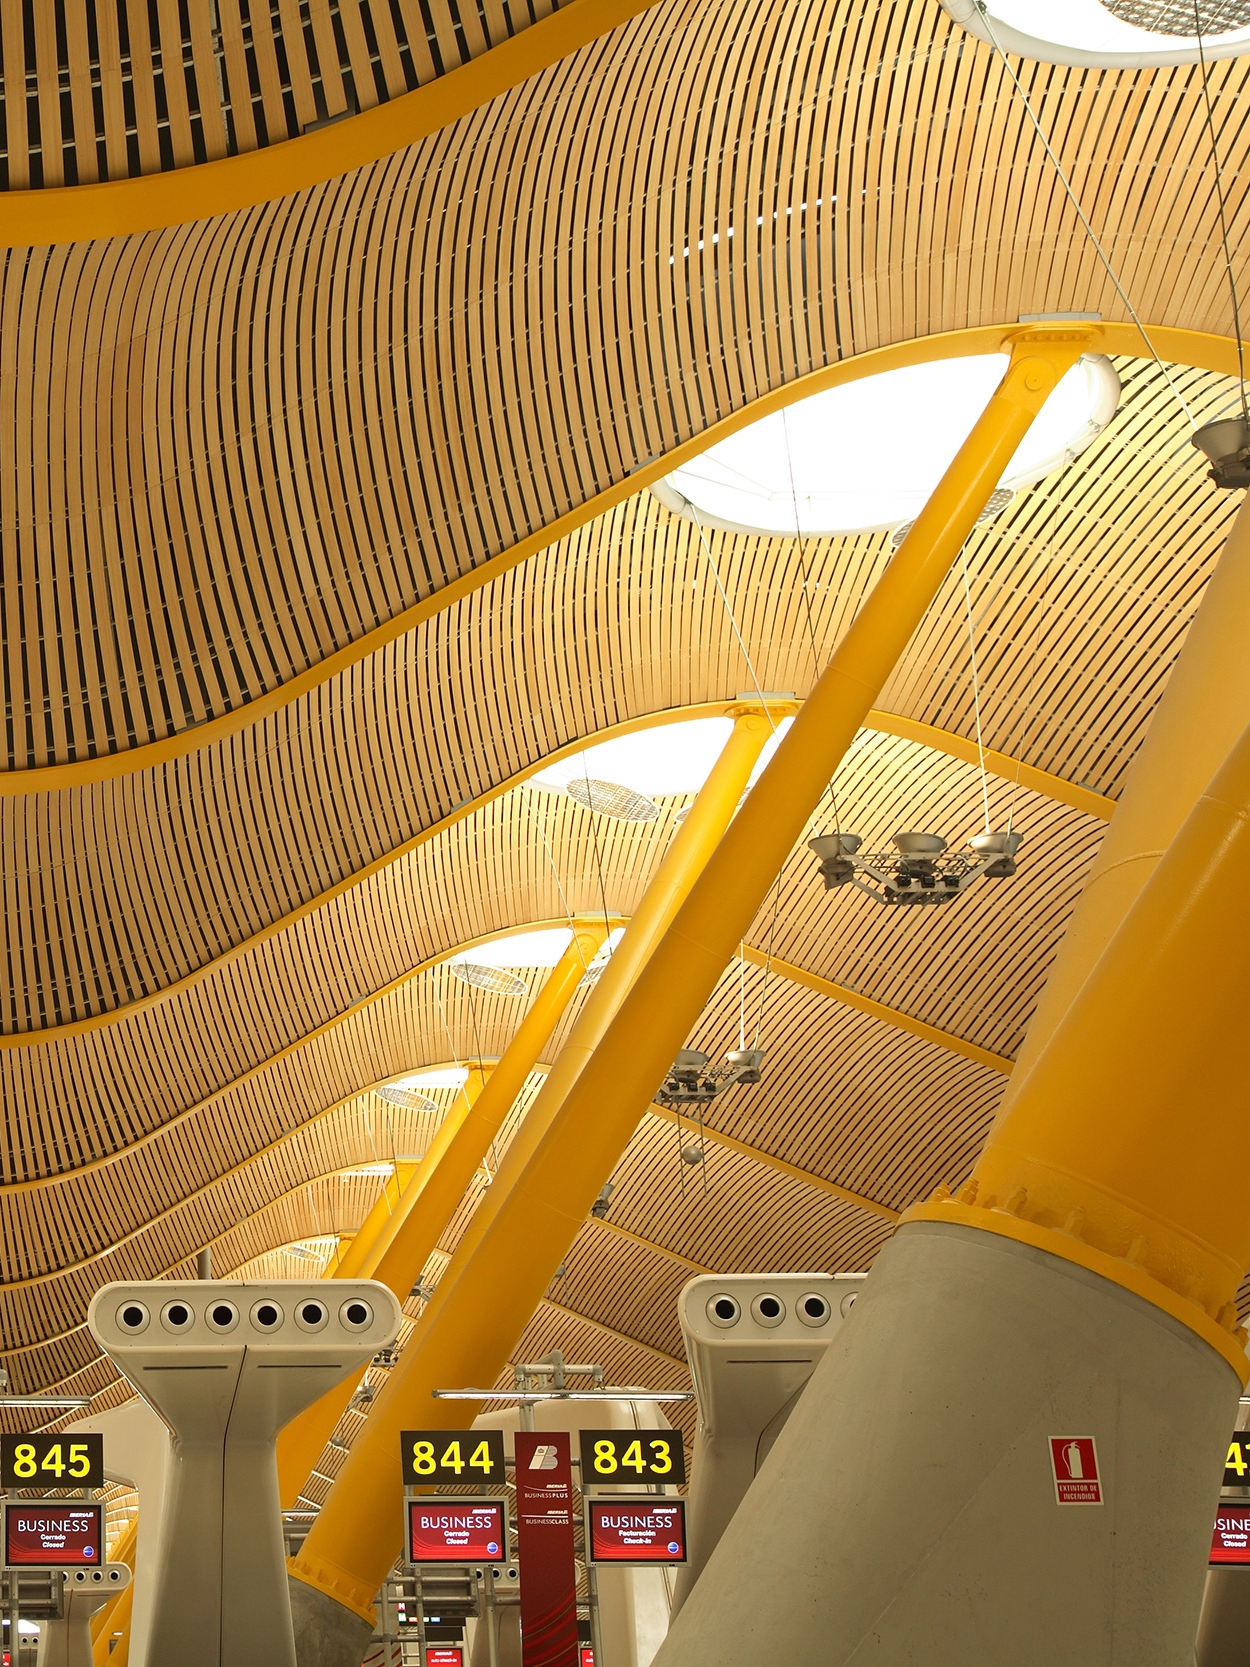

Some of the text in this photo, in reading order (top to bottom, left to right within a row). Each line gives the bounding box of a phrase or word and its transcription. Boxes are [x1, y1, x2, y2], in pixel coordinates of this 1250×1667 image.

[13, 1444, 91, 1478] 845
[413, 1441, 494, 1475] 844
[594, 1440, 673, 1474] 843
[18, 1520, 89, 1532] BUSINESS
[421, 1516, 492, 1529] BUSINESS
[601, 1516, 672, 1528] BUSINESS
